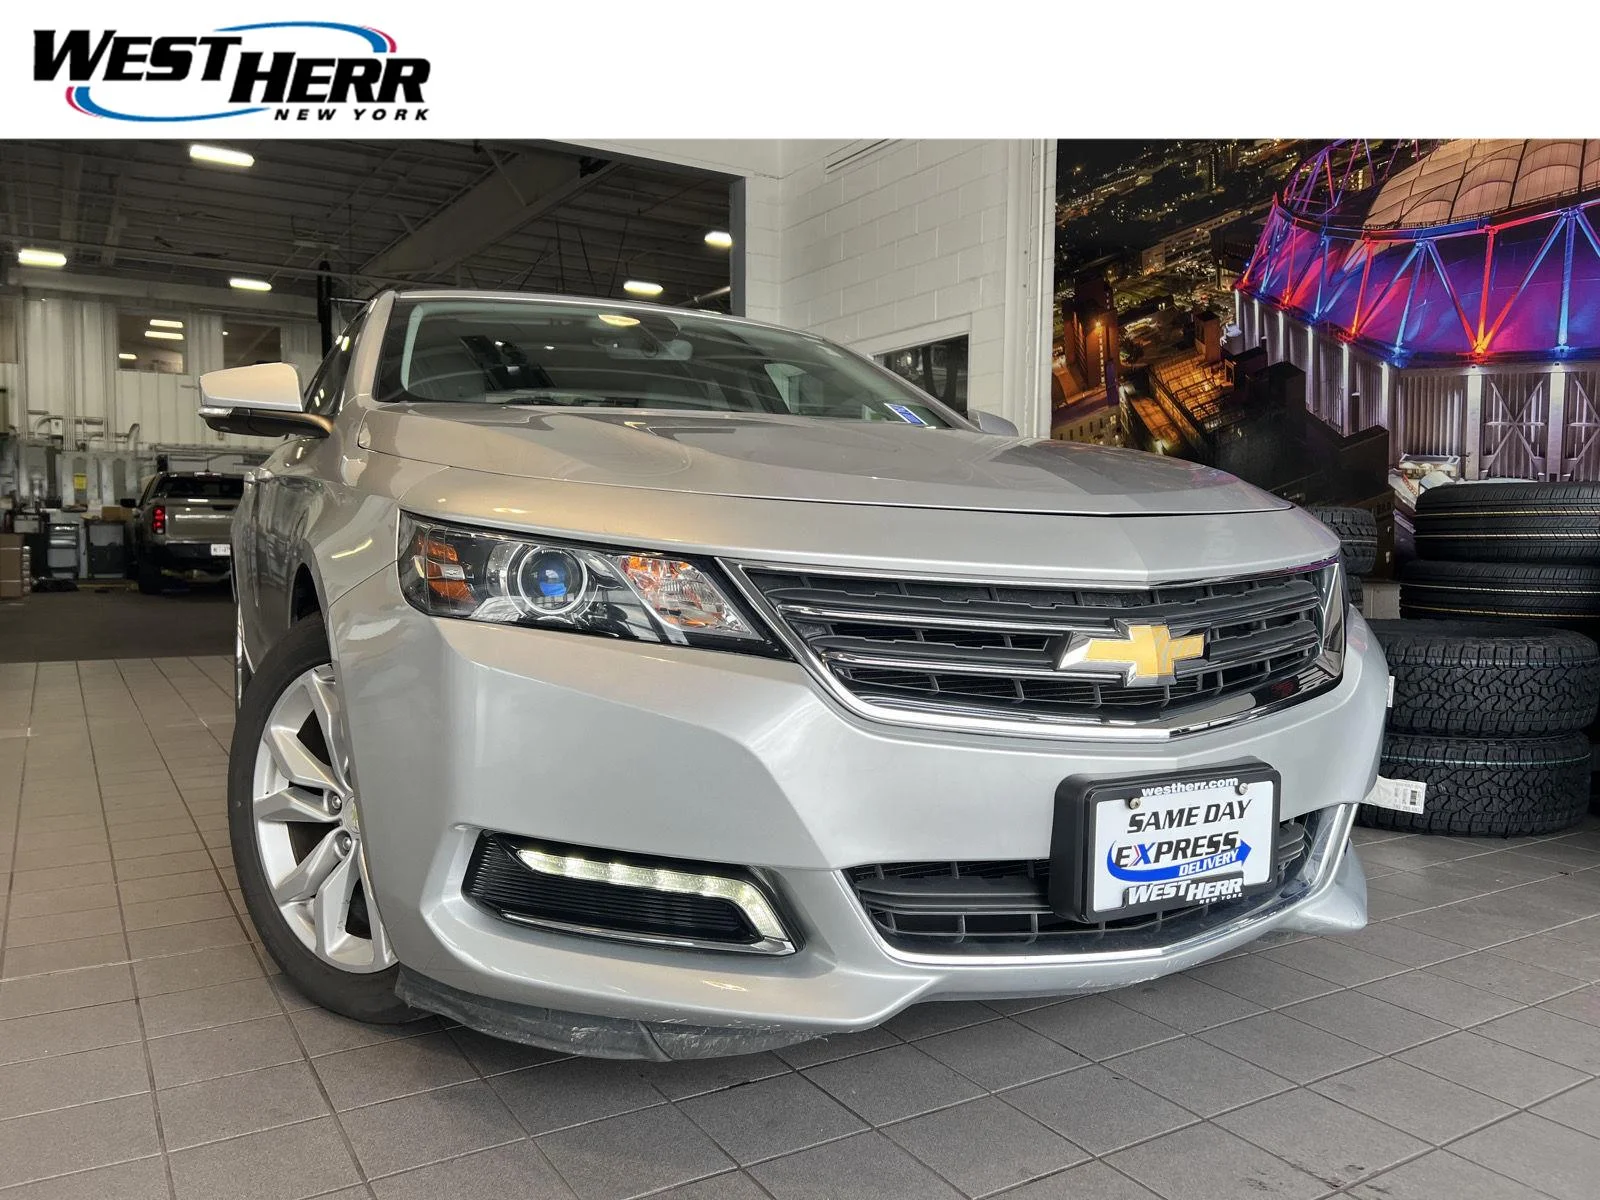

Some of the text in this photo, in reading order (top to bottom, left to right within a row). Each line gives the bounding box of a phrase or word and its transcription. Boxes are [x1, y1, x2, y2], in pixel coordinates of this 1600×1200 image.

[1141, 777, 1239, 797] westherr.com
[1127, 798, 1252, 834] SAME DAY
[1114, 831, 1239, 868] EXPRESS
[1178, 849, 1240, 877] DELIVERY
[1221, 892, 1243, 901] YORK
